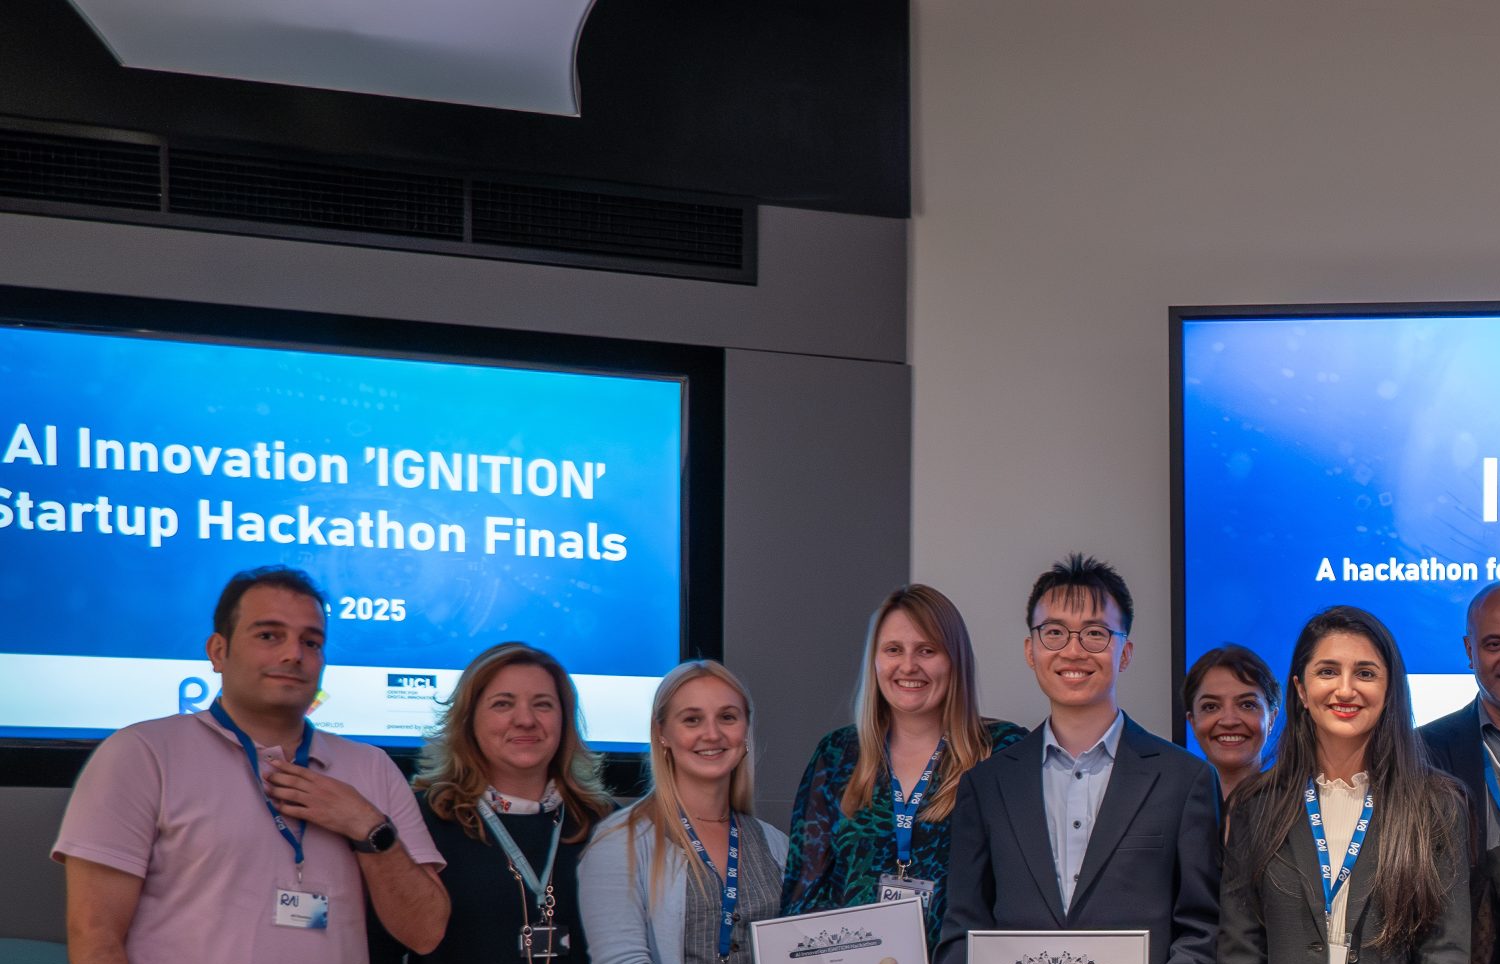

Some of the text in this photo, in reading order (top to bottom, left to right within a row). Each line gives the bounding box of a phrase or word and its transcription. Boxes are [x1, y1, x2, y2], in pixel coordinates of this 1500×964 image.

[3, 422, 57, 466] AI
[78, 427, 349, 483] Innovation
[0, 486, 628, 562] Startup Hackathon Finals
[1315, 557, 1337, 581] A
[1343, 557, 1478, 581] hackathon
[339, 596, 406, 622] 2025
[402, 676, 435, 688] UCL
